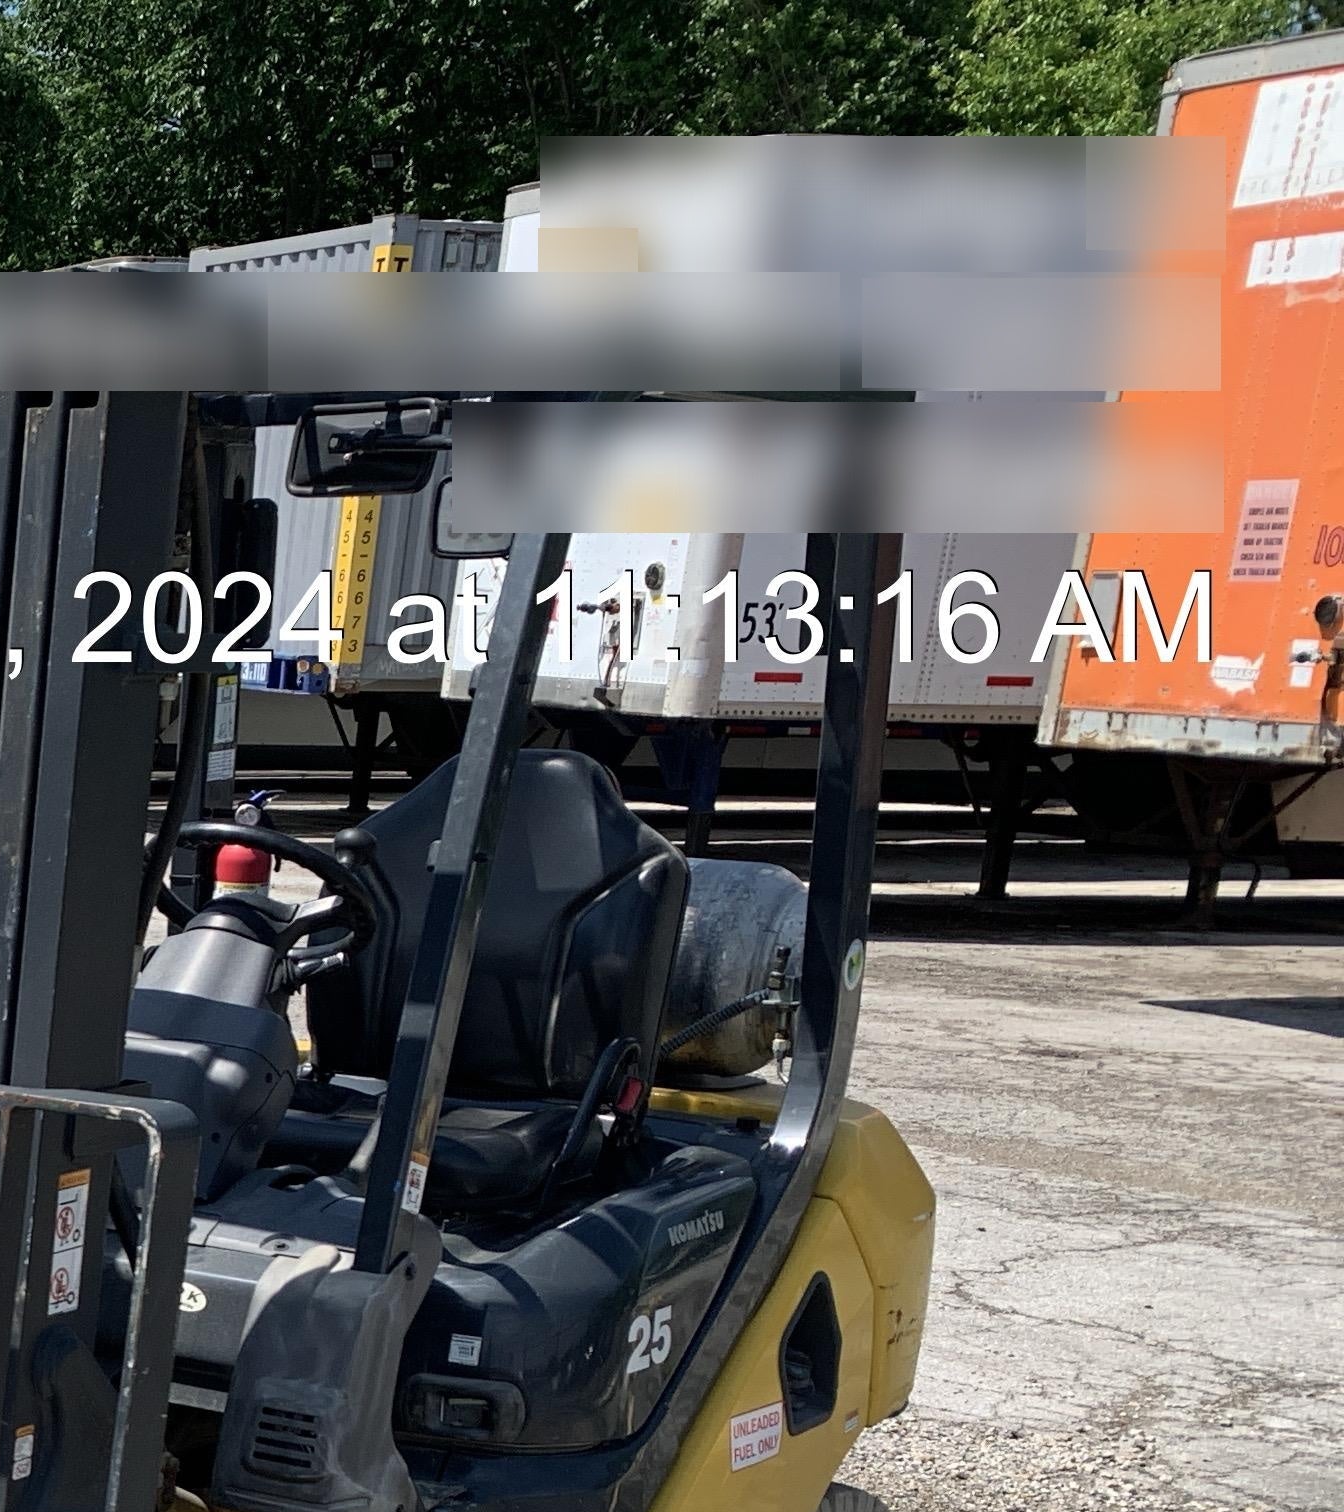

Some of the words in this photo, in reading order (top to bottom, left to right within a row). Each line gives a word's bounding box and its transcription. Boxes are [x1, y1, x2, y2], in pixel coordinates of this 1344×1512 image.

[347, 495, 376, 653] 45-6673
[668, 1209, 725, 1247] KOMATSU
[626, 1304, 673, 1375] 25
[733, 1410, 780, 1439] UNLEADED
[734, 1443, 757, 1463] FUEL
[758, 1434, 779, 1455] ONLY
